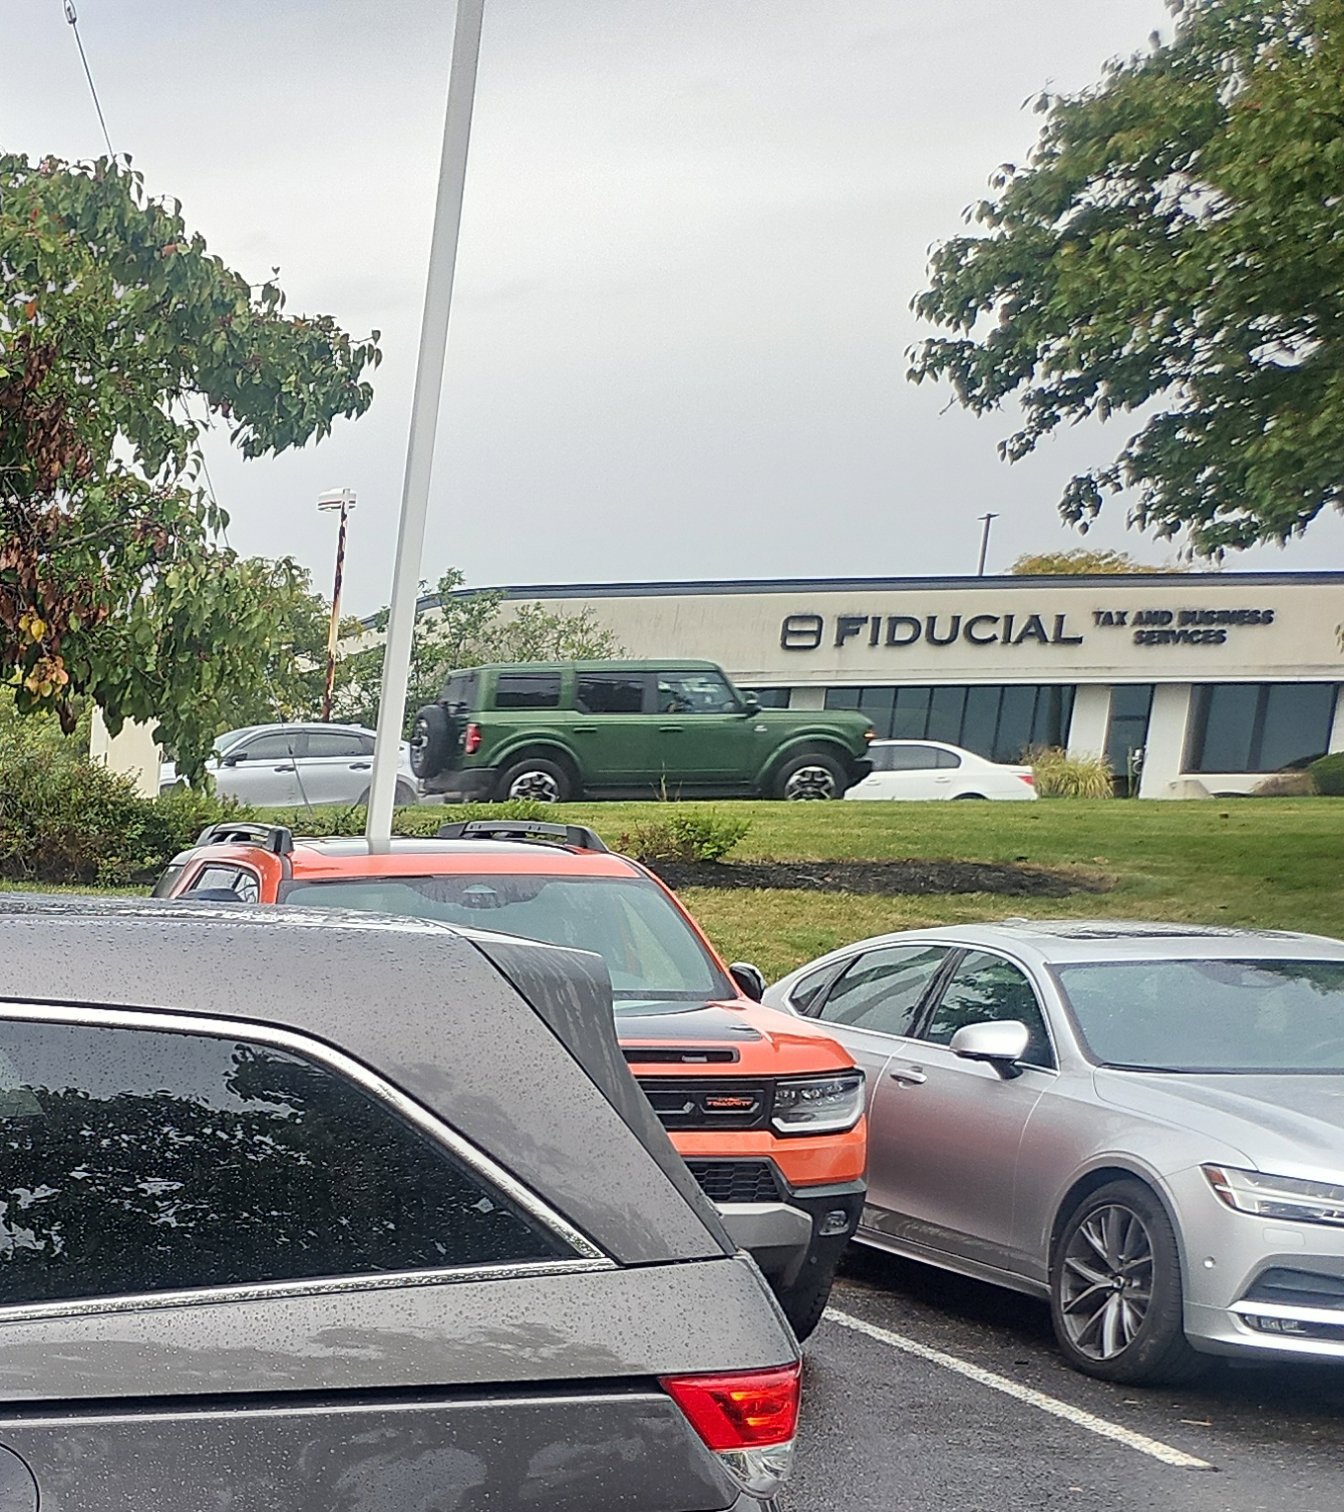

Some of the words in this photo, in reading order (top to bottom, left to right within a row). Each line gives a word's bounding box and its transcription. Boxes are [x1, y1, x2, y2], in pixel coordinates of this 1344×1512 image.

[1092, 610, 1129, 627] TAX
[1130, 610, 1174, 627] AND
[833, 613, 1084, 647] FIDUCIAL
[1132, 628, 1228, 646] SERVICES
